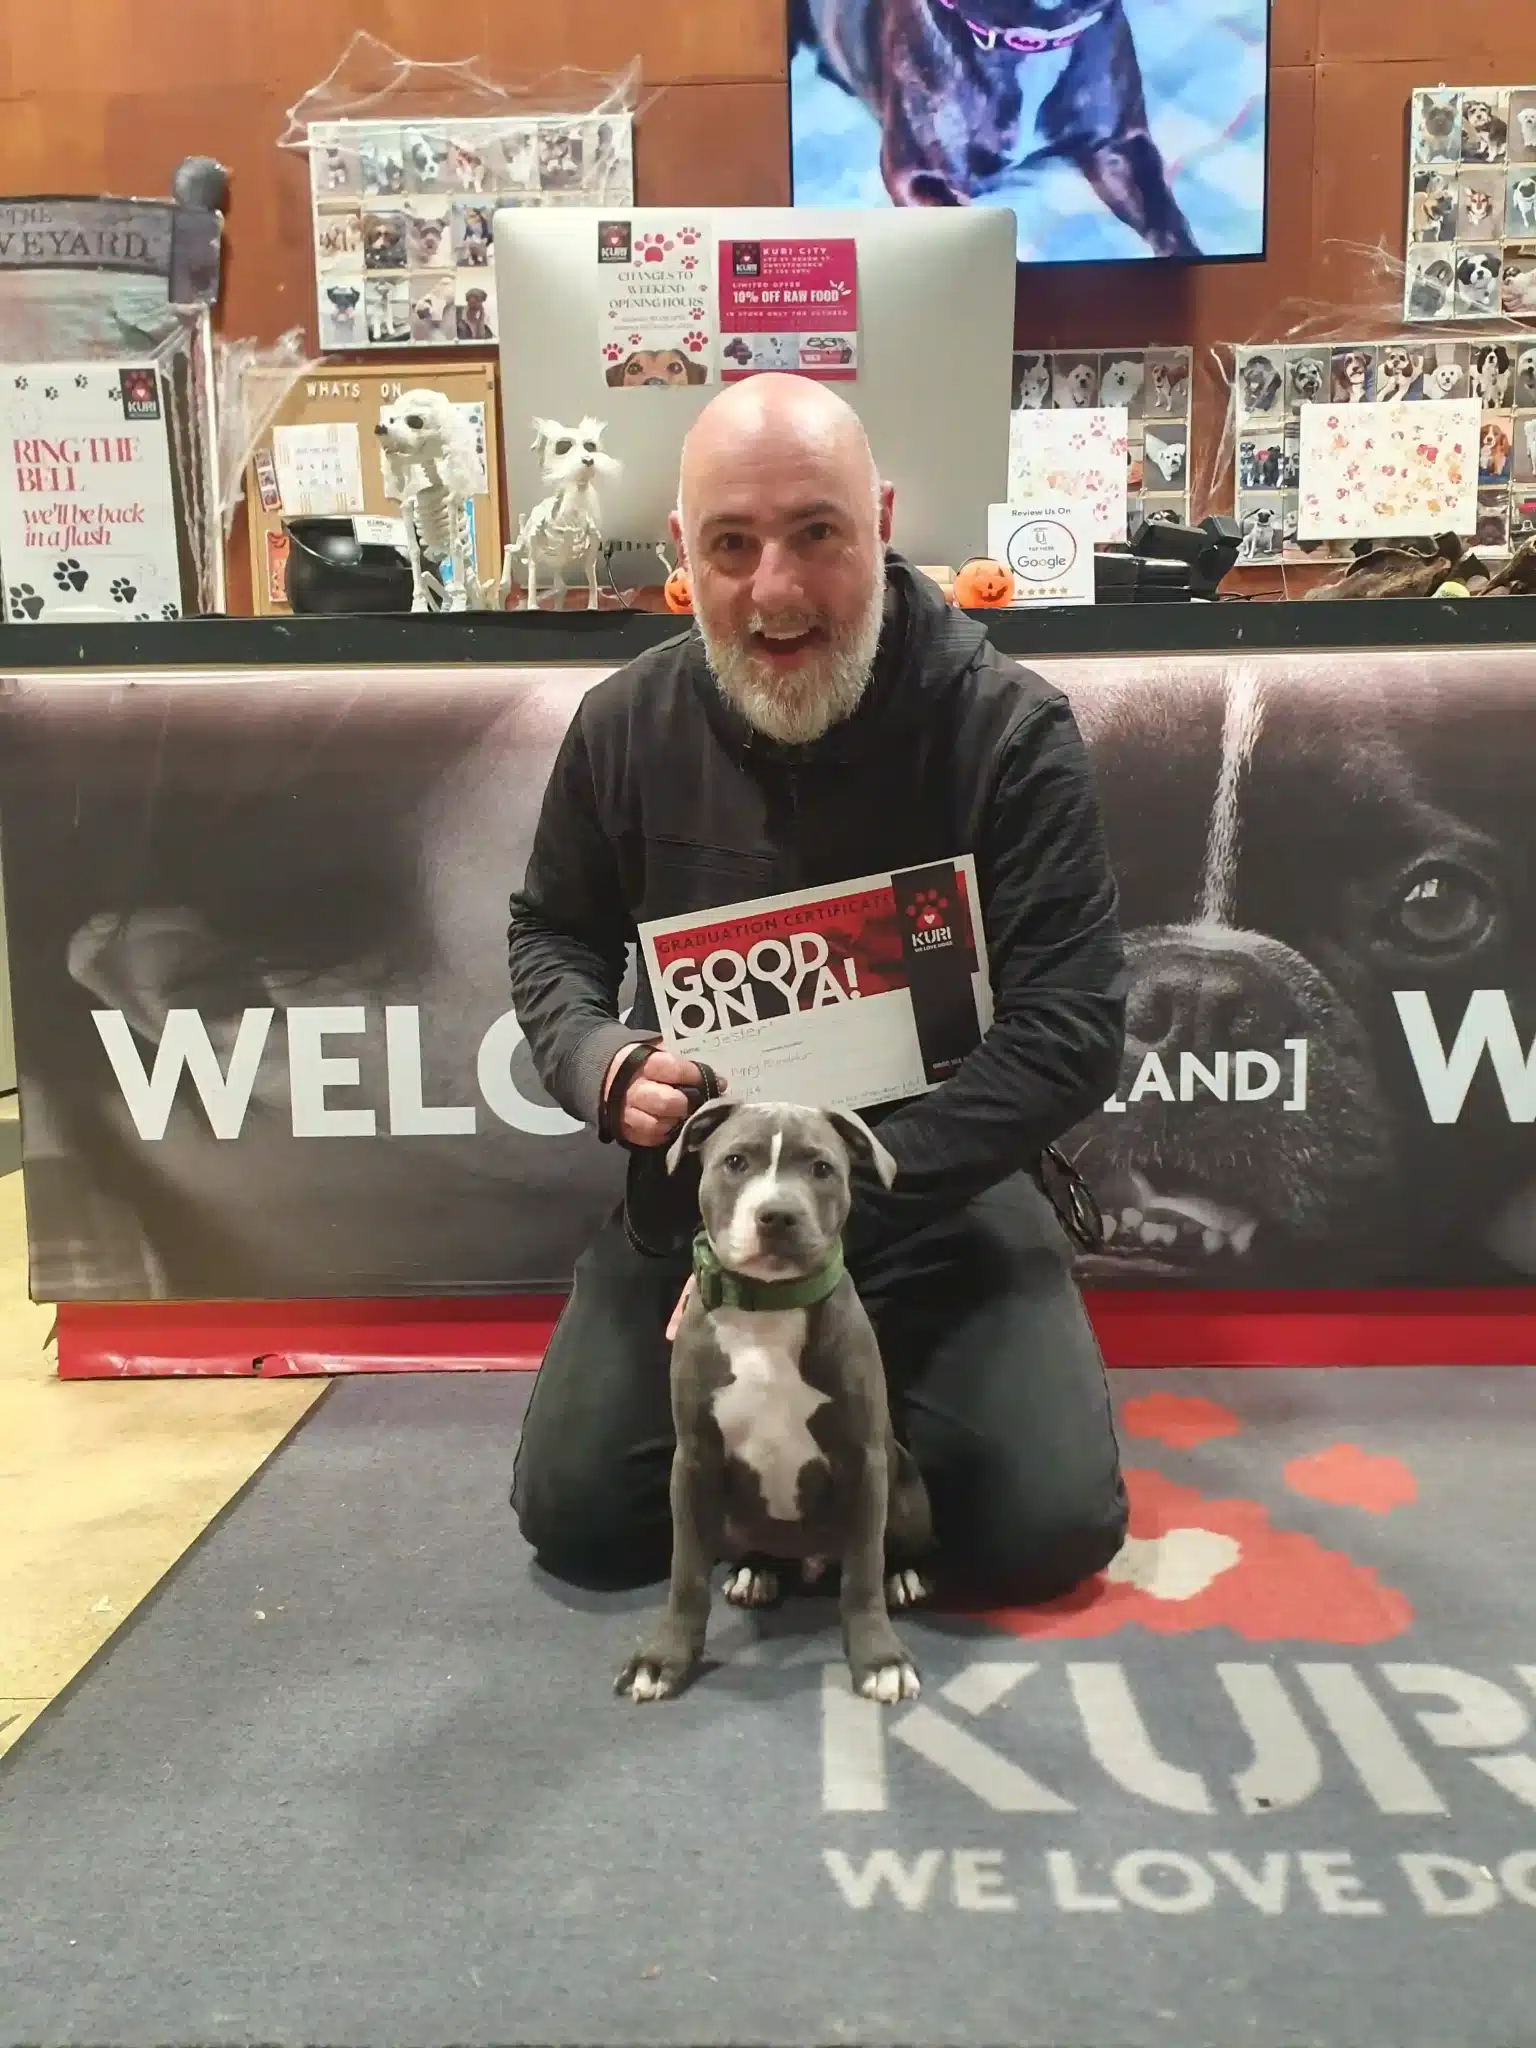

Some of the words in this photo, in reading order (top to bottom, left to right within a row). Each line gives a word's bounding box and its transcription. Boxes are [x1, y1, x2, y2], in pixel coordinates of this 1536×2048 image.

[6, 207, 52, 225] THE
[799, 247, 827, 256] CITY
[618, 271, 675, 281] CHANGES
[676, 271, 694, 281] TO
[627, 284, 685, 294] WEEKEND
[733, 290, 760, 304] 10%
[761, 290, 781, 304] OFF
[783, 290, 808, 303] RAW
[810, 290, 840, 303] FOOD
[608, 299, 661, 309] OPENING
[662, 297, 705, 308] HOURS
[306, 382, 361, 398] WHATS
[380, 381, 402, 398] ON
[127, 400, 157, 413] KURI
[13, 438, 81, 464] RING
[82, 437, 144, 463] THE
[17, 467, 86, 492] BELL
[23, 503, 68, 525] we'll
[72, 504, 95, 525] be
[97, 503, 145, 524] back
[1011, 509, 1043, 517] Review
[1057, 507, 1071, 515] On
[25, 527, 44, 547] in
[47, 531, 60, 547] a
[60, 525, 112, 553] flash
[1017, 554, 1067, 570] Google
[657, 916, 779, 954] GRADUATION
[782, 893, 895, 927] CERTIFICATE
[911, 926, 953, 947] KURI
[660, 931, 830, 1001] GOOD
[668, 980, 760, 1041] ON
[767, 956, 863, 1016] YA!
[821, 1661, 1536, 1815] KUR
[822, 1849, 1019, 1913] WE
[1046, 1849, 1387, 1915] LOVE
